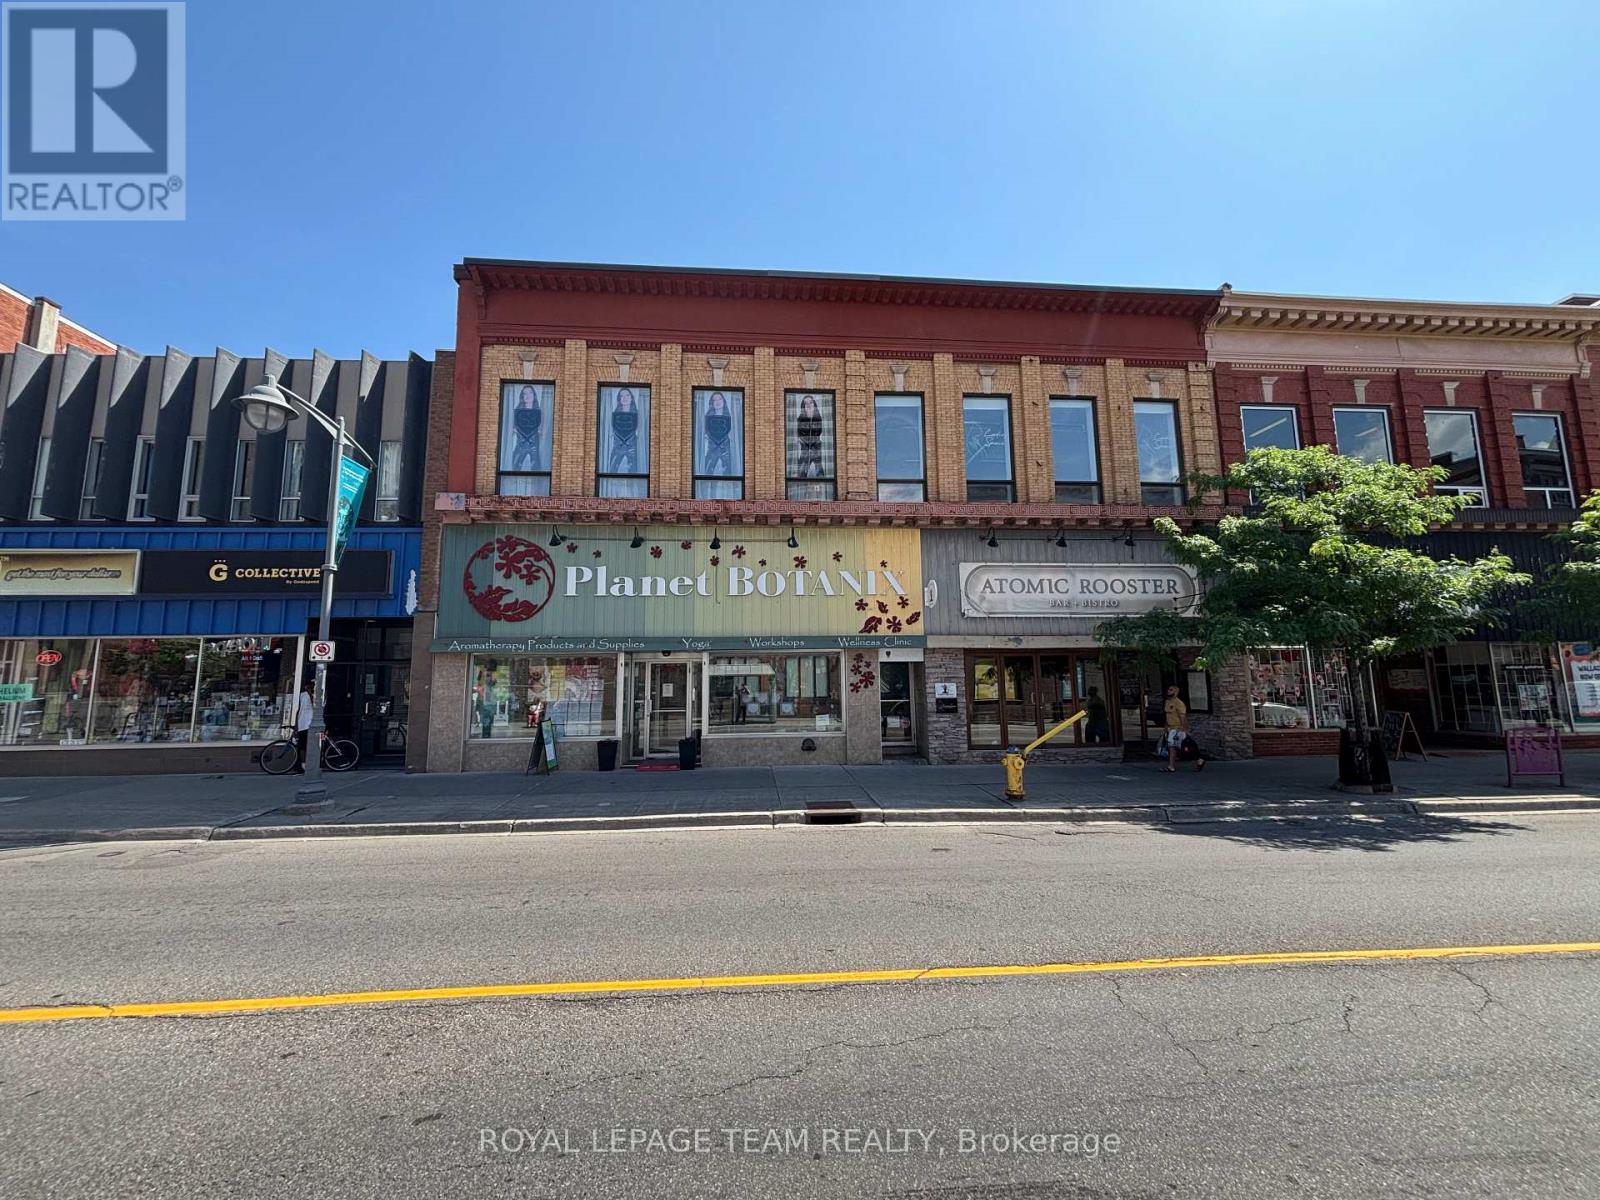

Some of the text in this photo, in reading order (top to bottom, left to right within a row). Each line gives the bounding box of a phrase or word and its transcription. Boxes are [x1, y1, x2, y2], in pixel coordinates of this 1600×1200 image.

[235, 568, 321, 579] COLLECTIVE
[564, 565, 906, 597] Planet BOTANIX
[980, 578, 1180, 595] ATOMIC ROOSTER
[1049, 599, 1070, 608] BAR
[1081, 599, 1119, 608] BISTRO
[448, 639, 525, 652] Aromatherapy
[528, 639, 574, 651] Products
[597, 638, 645, 651] Supplies
[681, 638, 712, 650] Yoga
[750, 637, 806, 648] Workshops
[837, 636, 912, 647] Wellness Clinic
